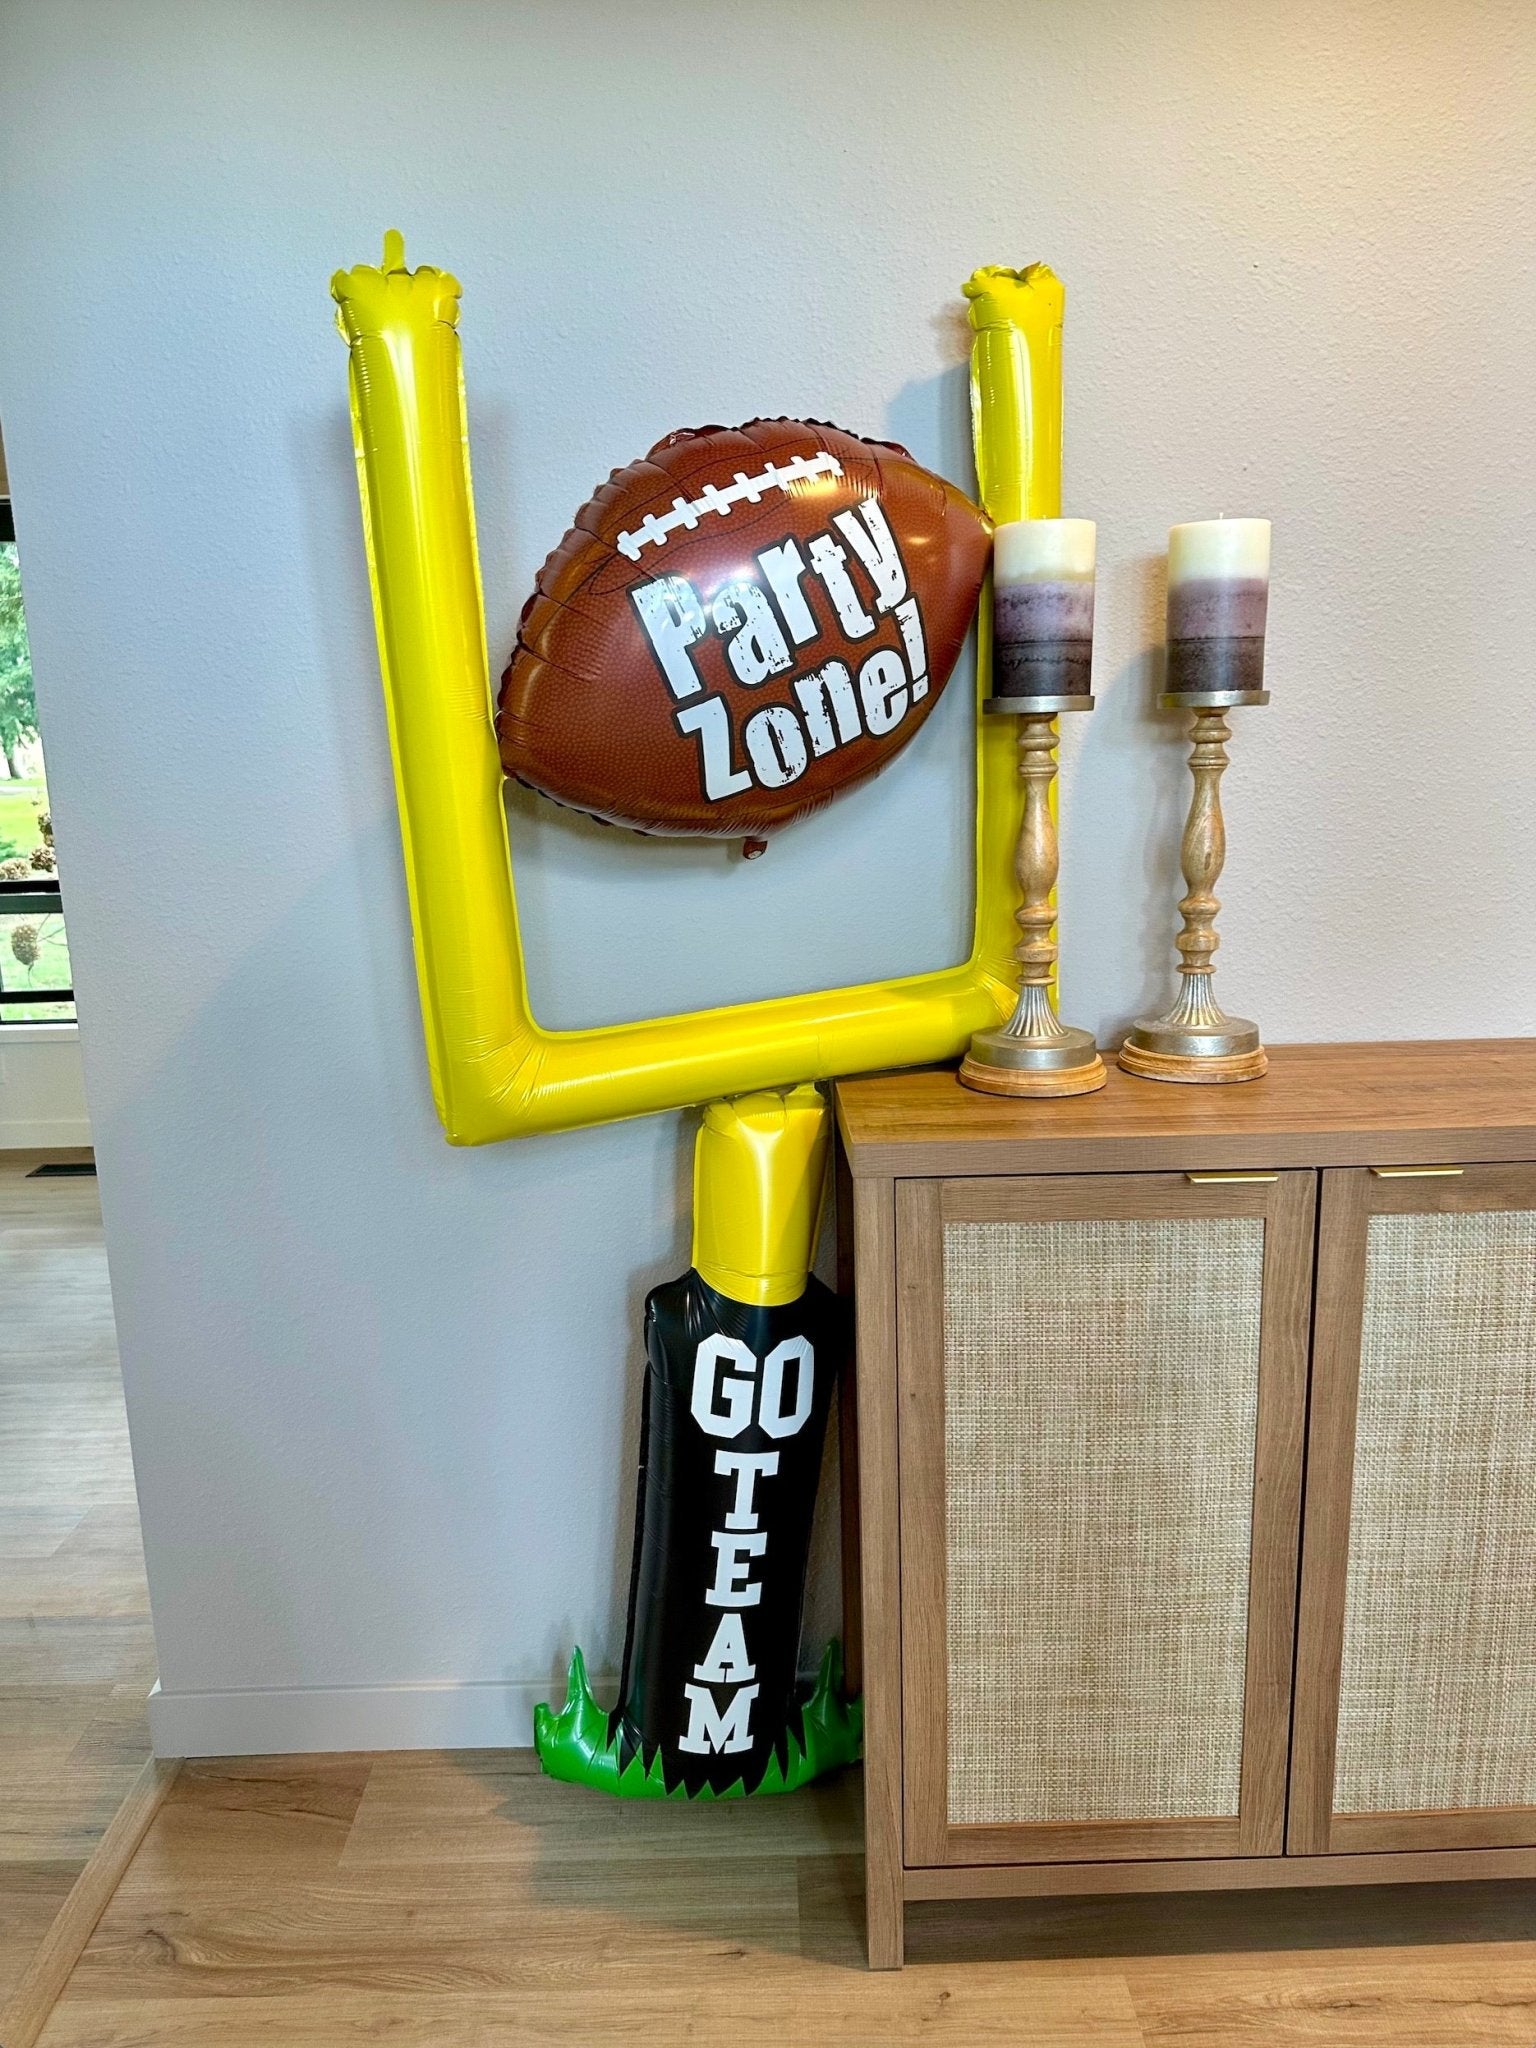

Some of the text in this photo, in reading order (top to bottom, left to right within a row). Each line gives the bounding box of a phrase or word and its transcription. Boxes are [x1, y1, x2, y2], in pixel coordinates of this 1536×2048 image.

[631, 498, 909, 699] Party
[677, 598, 929, 801] Zone!
[691, 1332, 815, 1439] GO
[678, 1449, 779, 1754] TEAM
